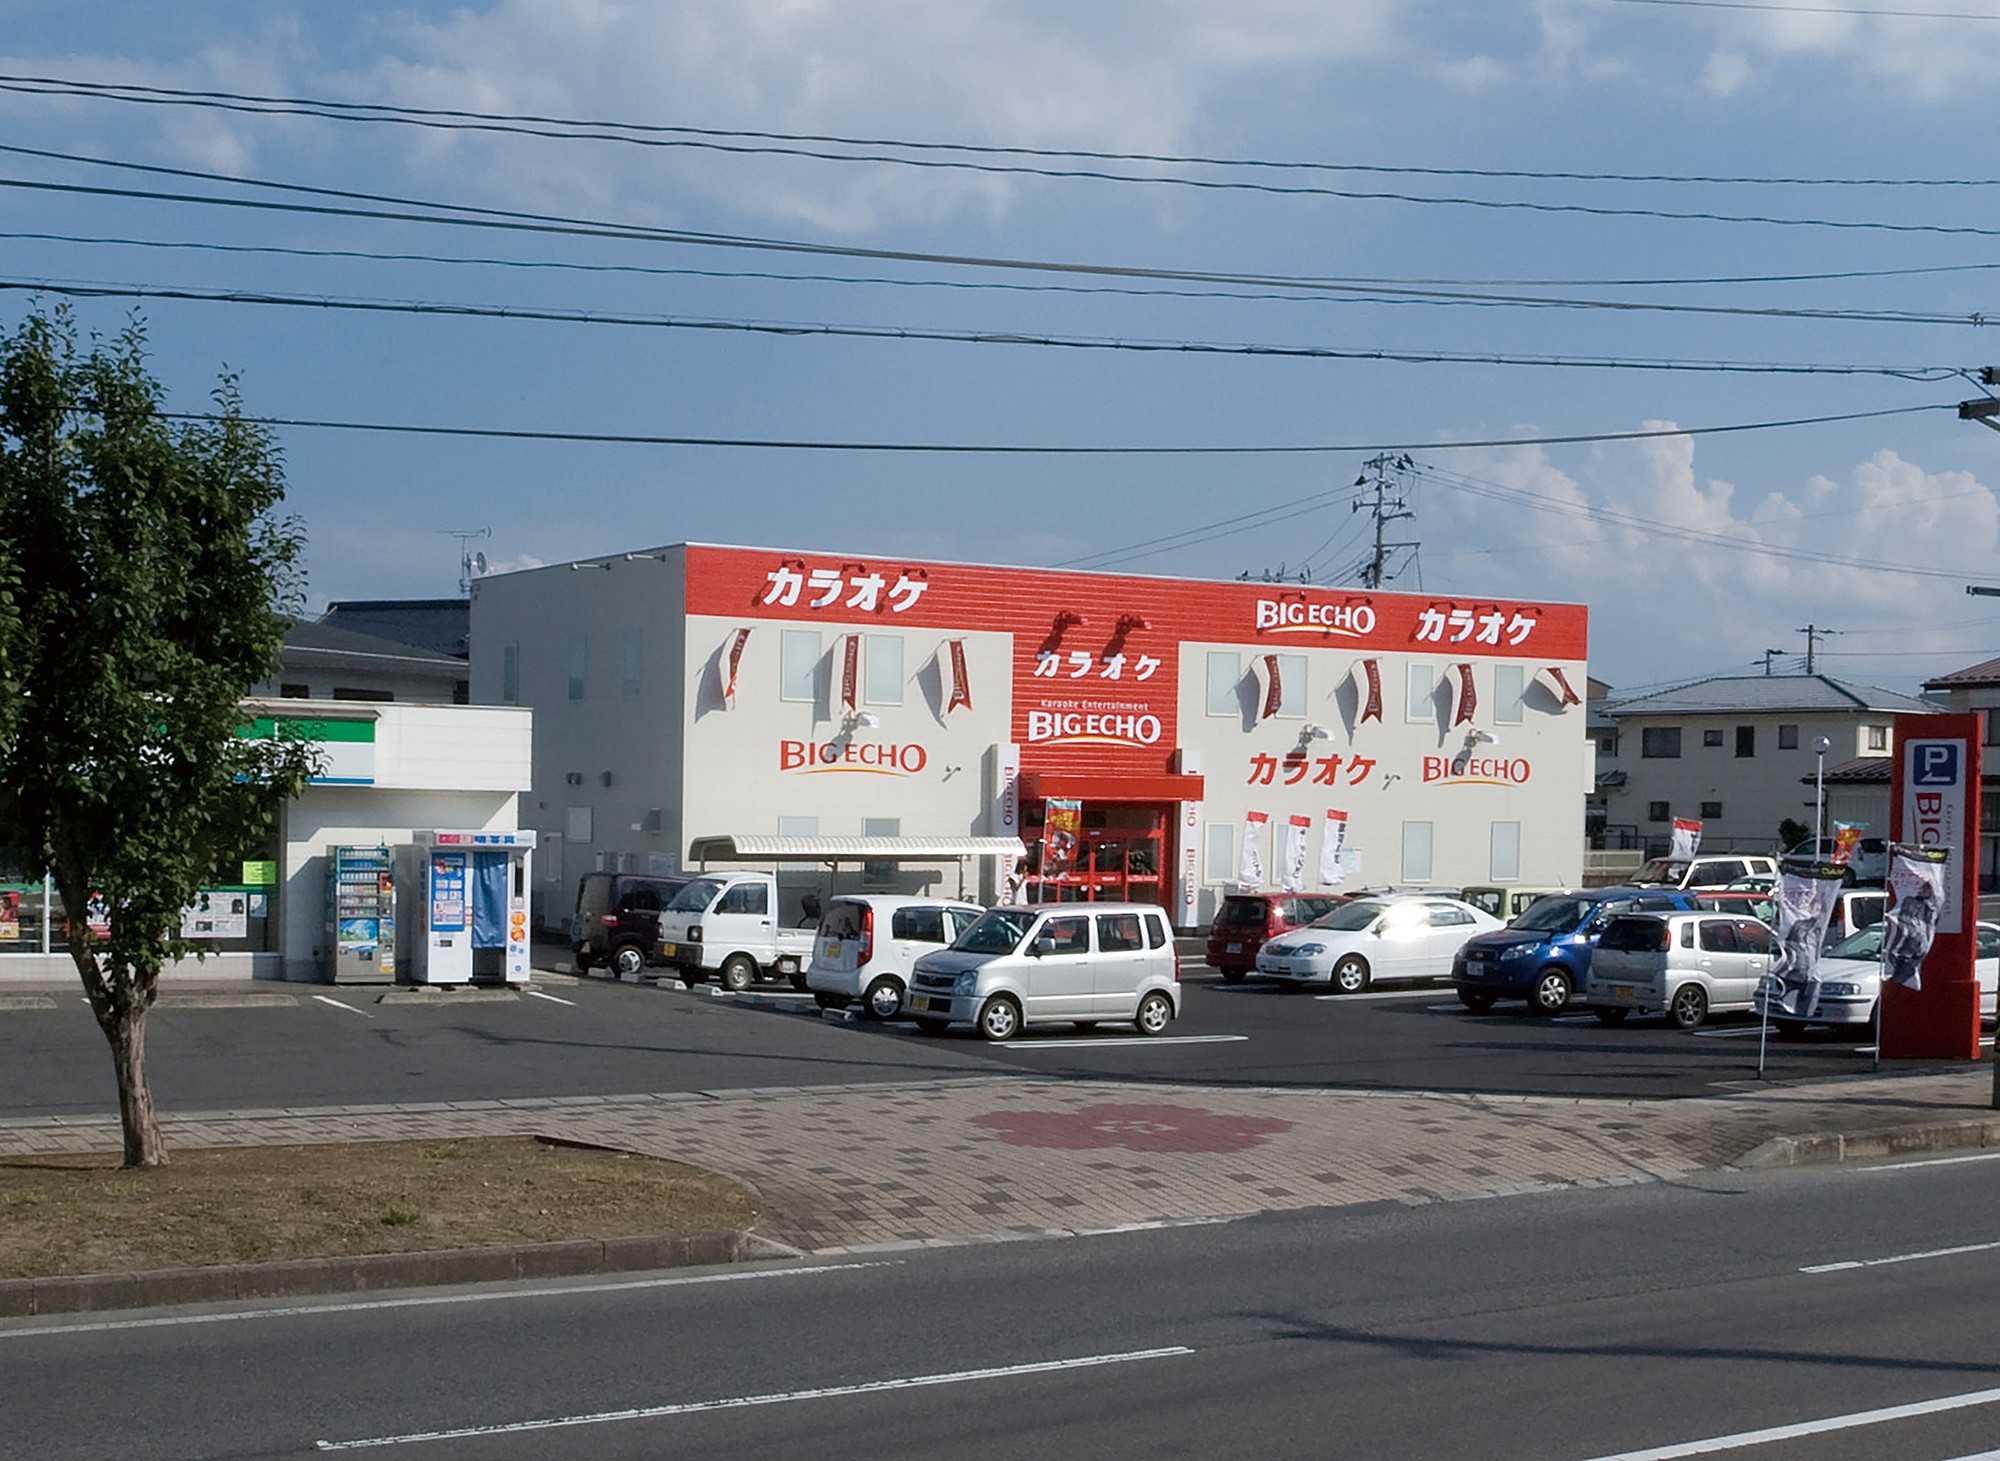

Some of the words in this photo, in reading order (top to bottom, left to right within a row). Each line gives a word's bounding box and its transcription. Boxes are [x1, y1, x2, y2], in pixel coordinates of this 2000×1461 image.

[763, 567, 928, 613] カラオケ
[1257, 599, 1304, 629] BIG
[1308, 604, 1376, 634] ECHO
[1416, 608, 1536, 646] カラオケ
[1033, 650, 1161, 681] カラオケ
[1041, 699, 1079, 709] Karaoke
[1081, 699, 1149, 711] Entertainment
[1028, 711, 1081, 742] BIG
[1086, 714, 1161, 744] ECHO
[780, 740, 838, 771] BIG
[845, 743, 927, 773] ECHO
[1247, 752, 1377, 786] カラオケ
[1423, 756, 1465, 783] BIG
[1469, 758, 1531, 783] ECHO
[1915, 792, 1943, 844] BIG
